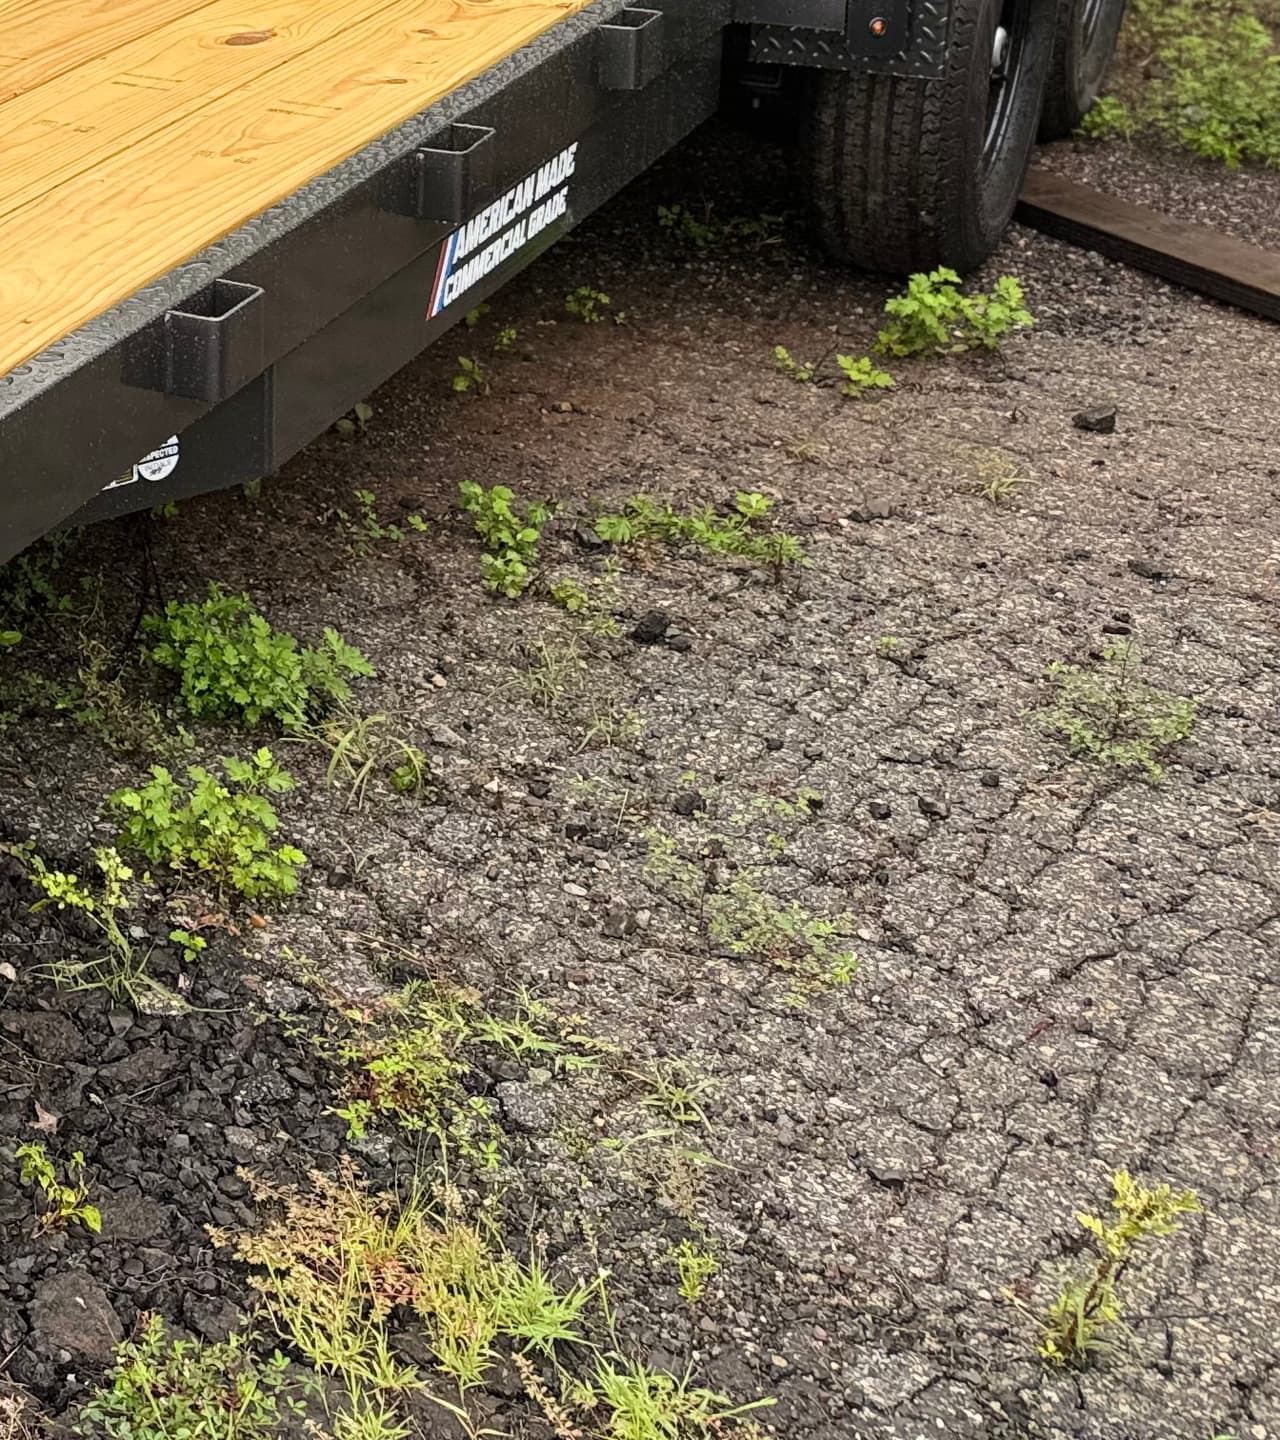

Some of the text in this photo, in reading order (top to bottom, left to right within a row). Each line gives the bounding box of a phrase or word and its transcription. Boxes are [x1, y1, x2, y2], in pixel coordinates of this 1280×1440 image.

[443, 185, 568, 307] COMMERCIAL GRADE
[453, 141, 578, 264] AMERICAN MADE
[139, 444, 179, 463] PECTED
